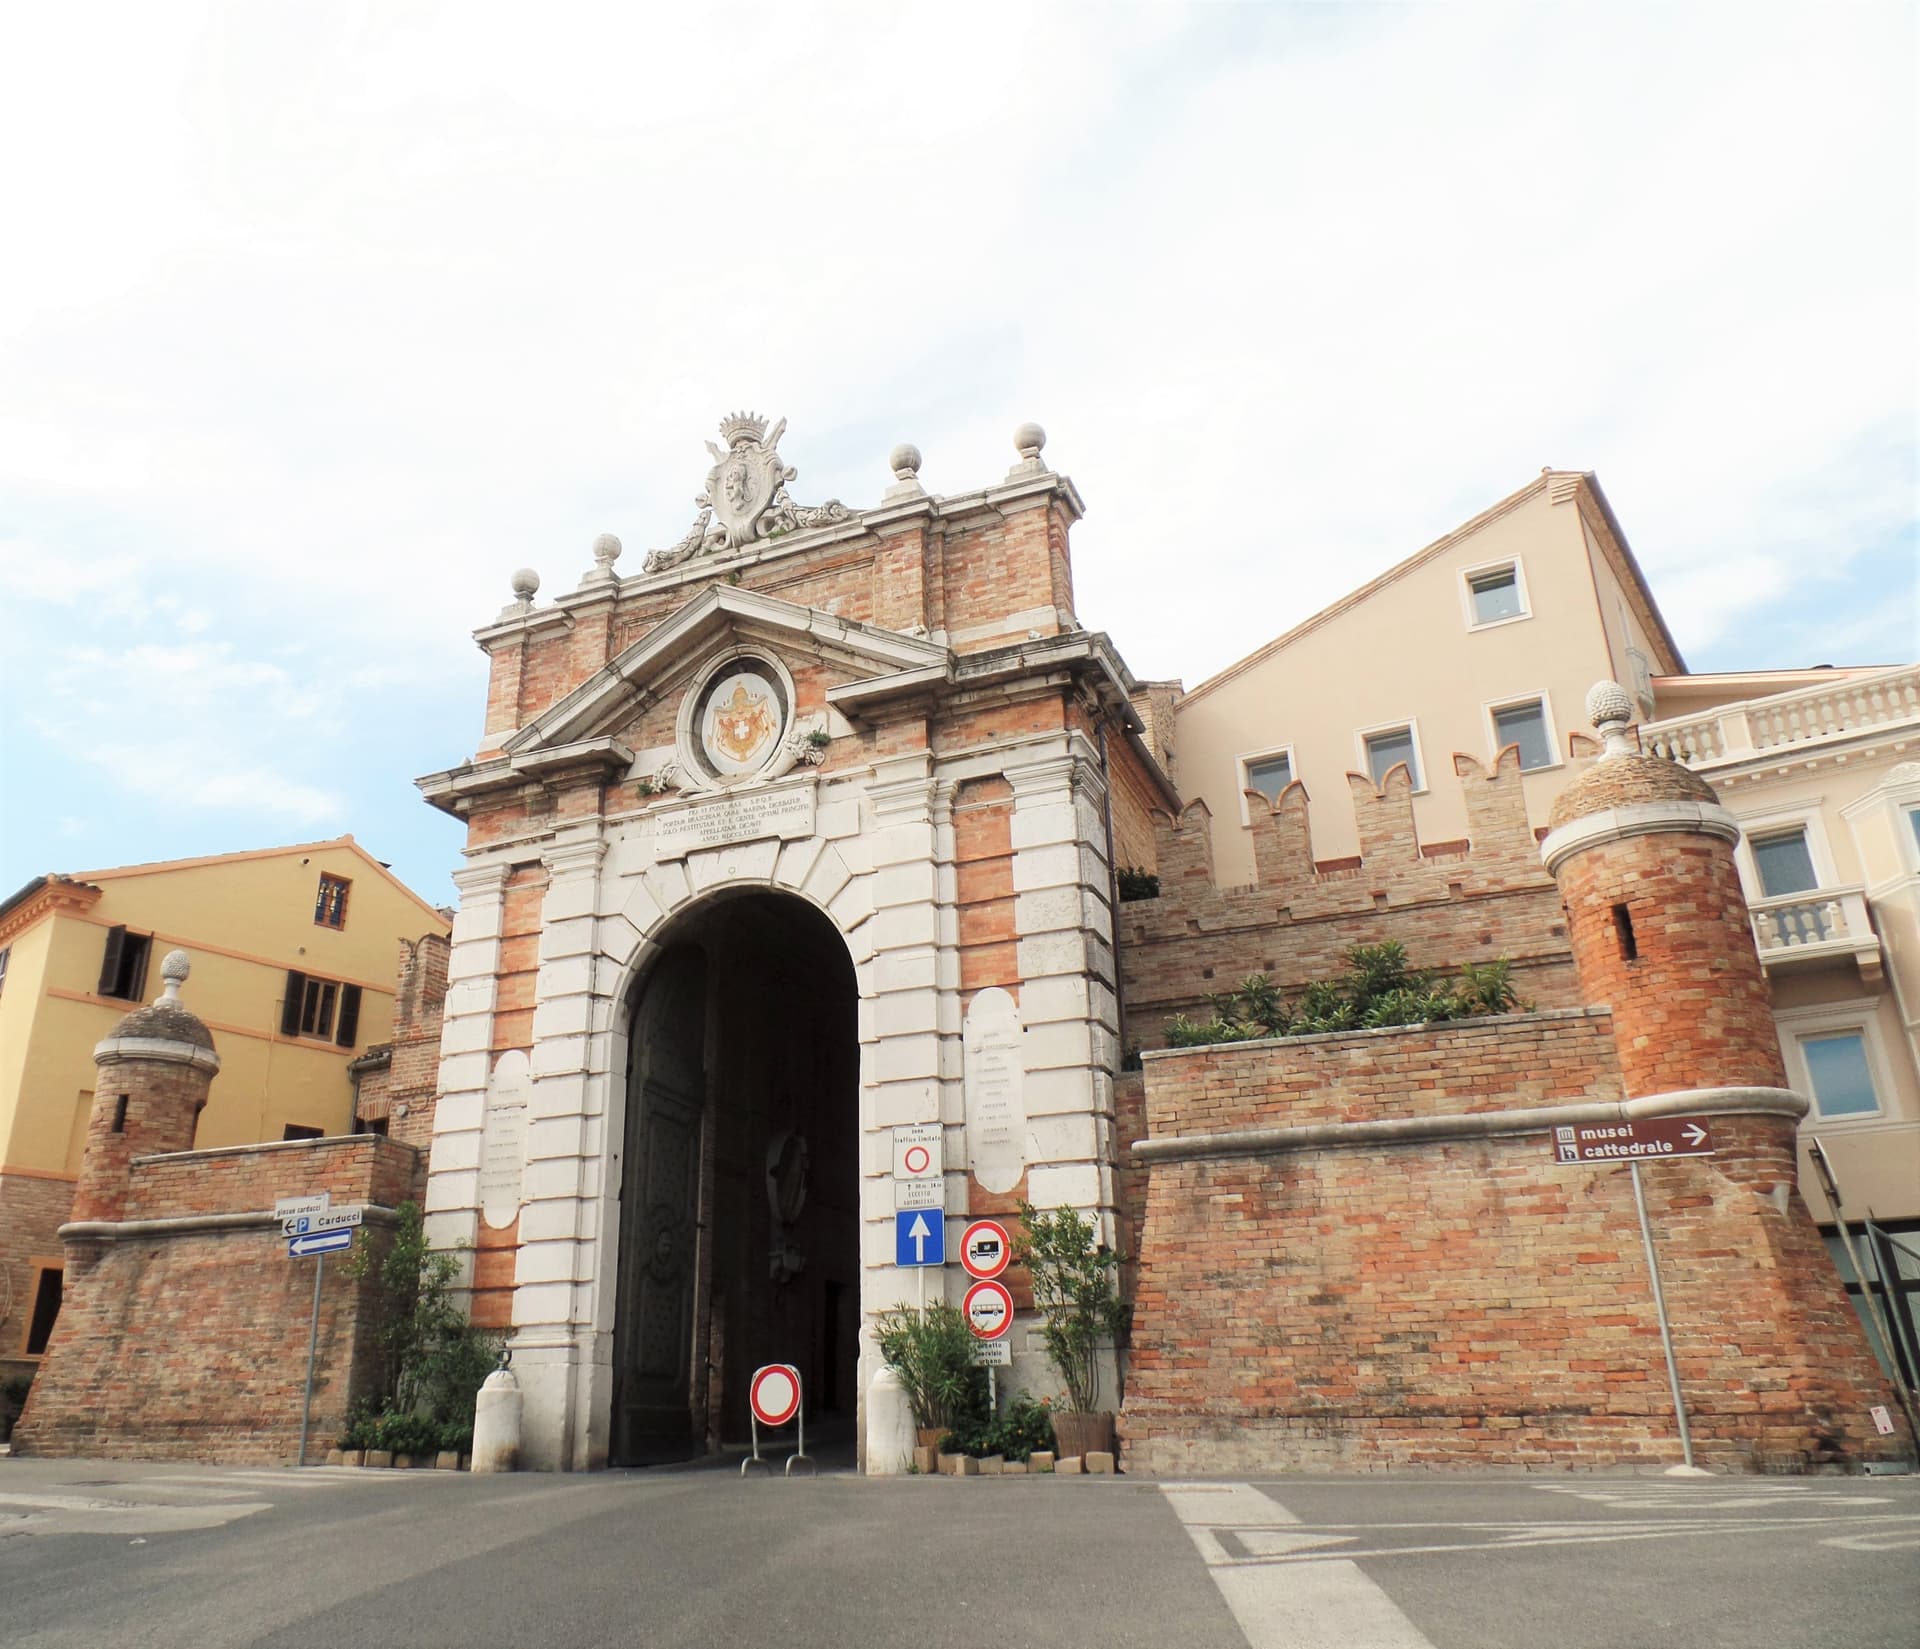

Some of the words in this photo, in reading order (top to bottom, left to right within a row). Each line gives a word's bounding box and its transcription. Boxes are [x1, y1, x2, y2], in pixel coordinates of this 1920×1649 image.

[1581, 1124, 1634, 1140] musei
[1584, 1140, 1673, 1158] cattedrale
[297, 1205, 321, 1214] carducci
[318, 1211, 360, 1226] Carducci
